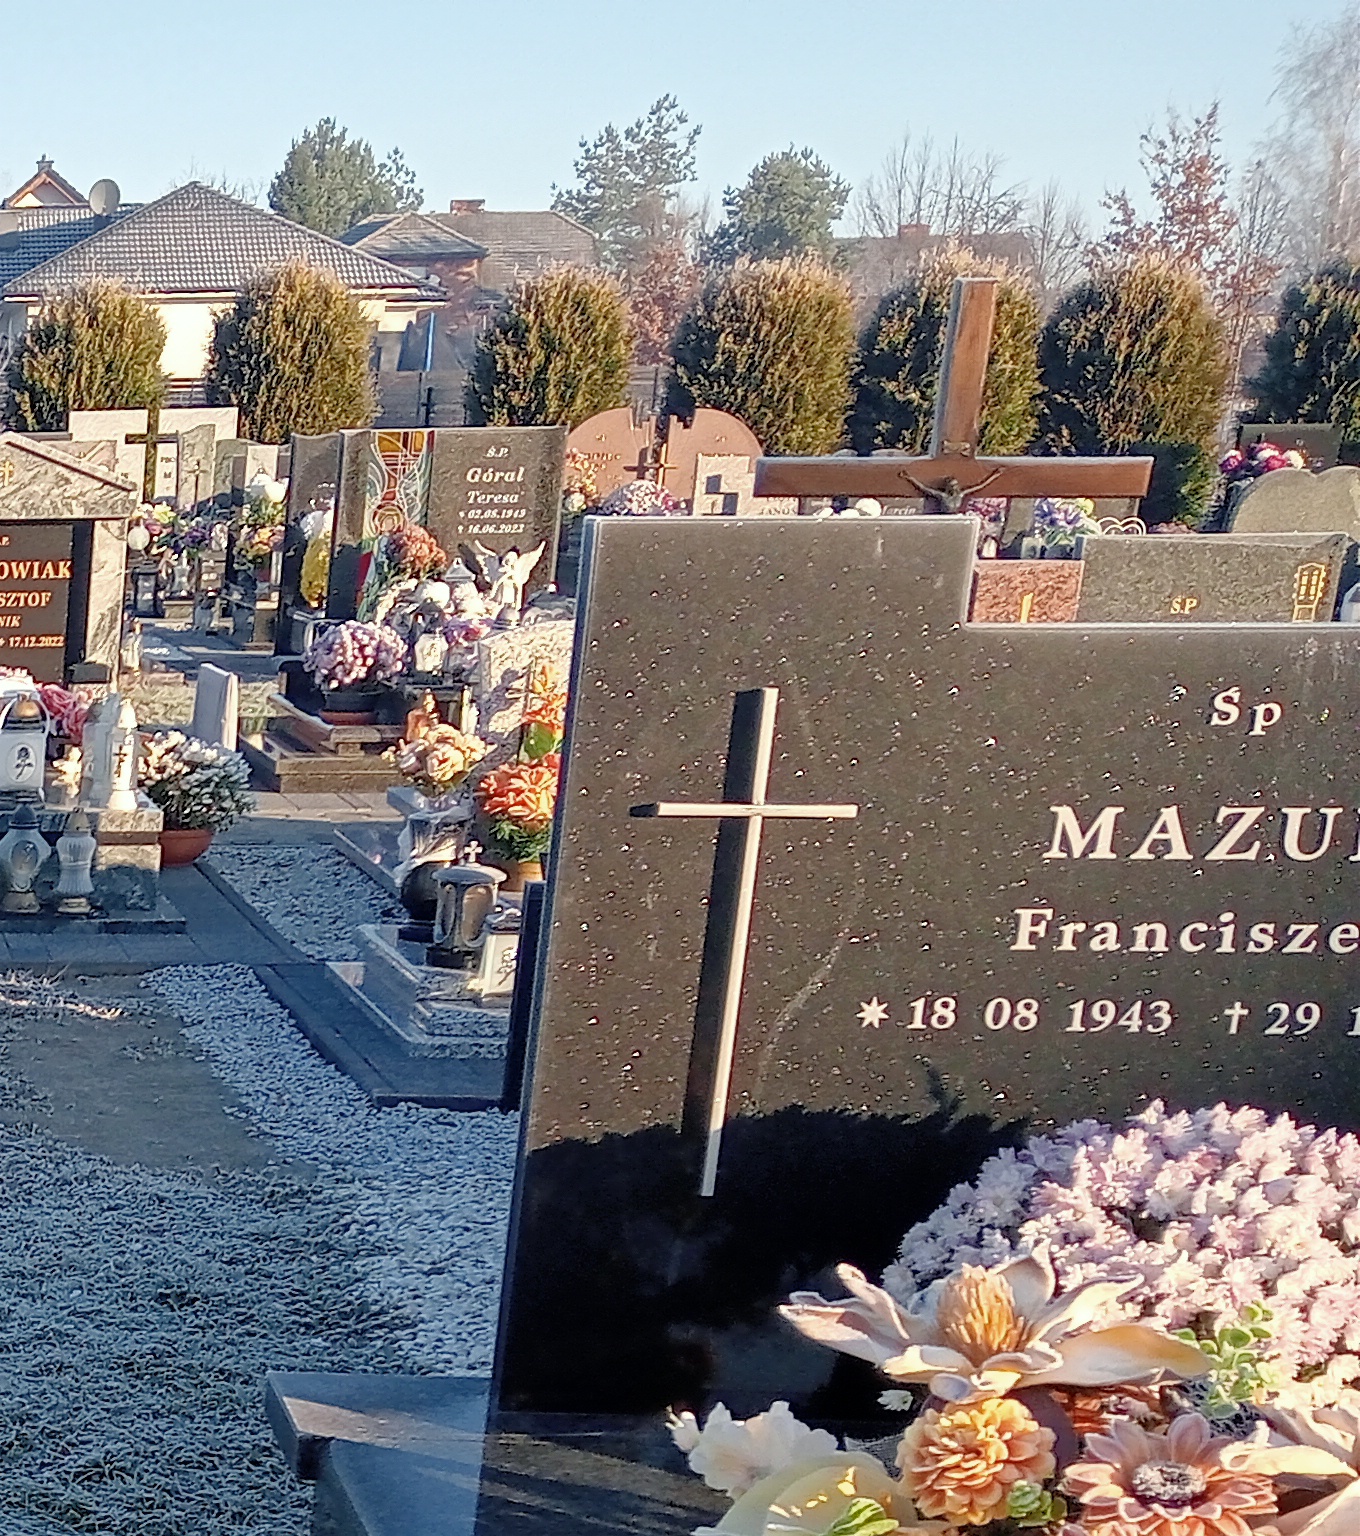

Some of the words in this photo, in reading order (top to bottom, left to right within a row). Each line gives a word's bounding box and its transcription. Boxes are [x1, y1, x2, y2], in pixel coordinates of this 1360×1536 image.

[466, 466, 525, 483] Góral
[467, 490, 519, 504] Teresa
[8, 635, 65, 648] 17.12.2022
[906, 997, 957, 1030] 18
[984, 997, 1040, 1031] 08
[1065, 999, 1173, 1034] 1943
[1264, 1001, 1322, 1036] 29
